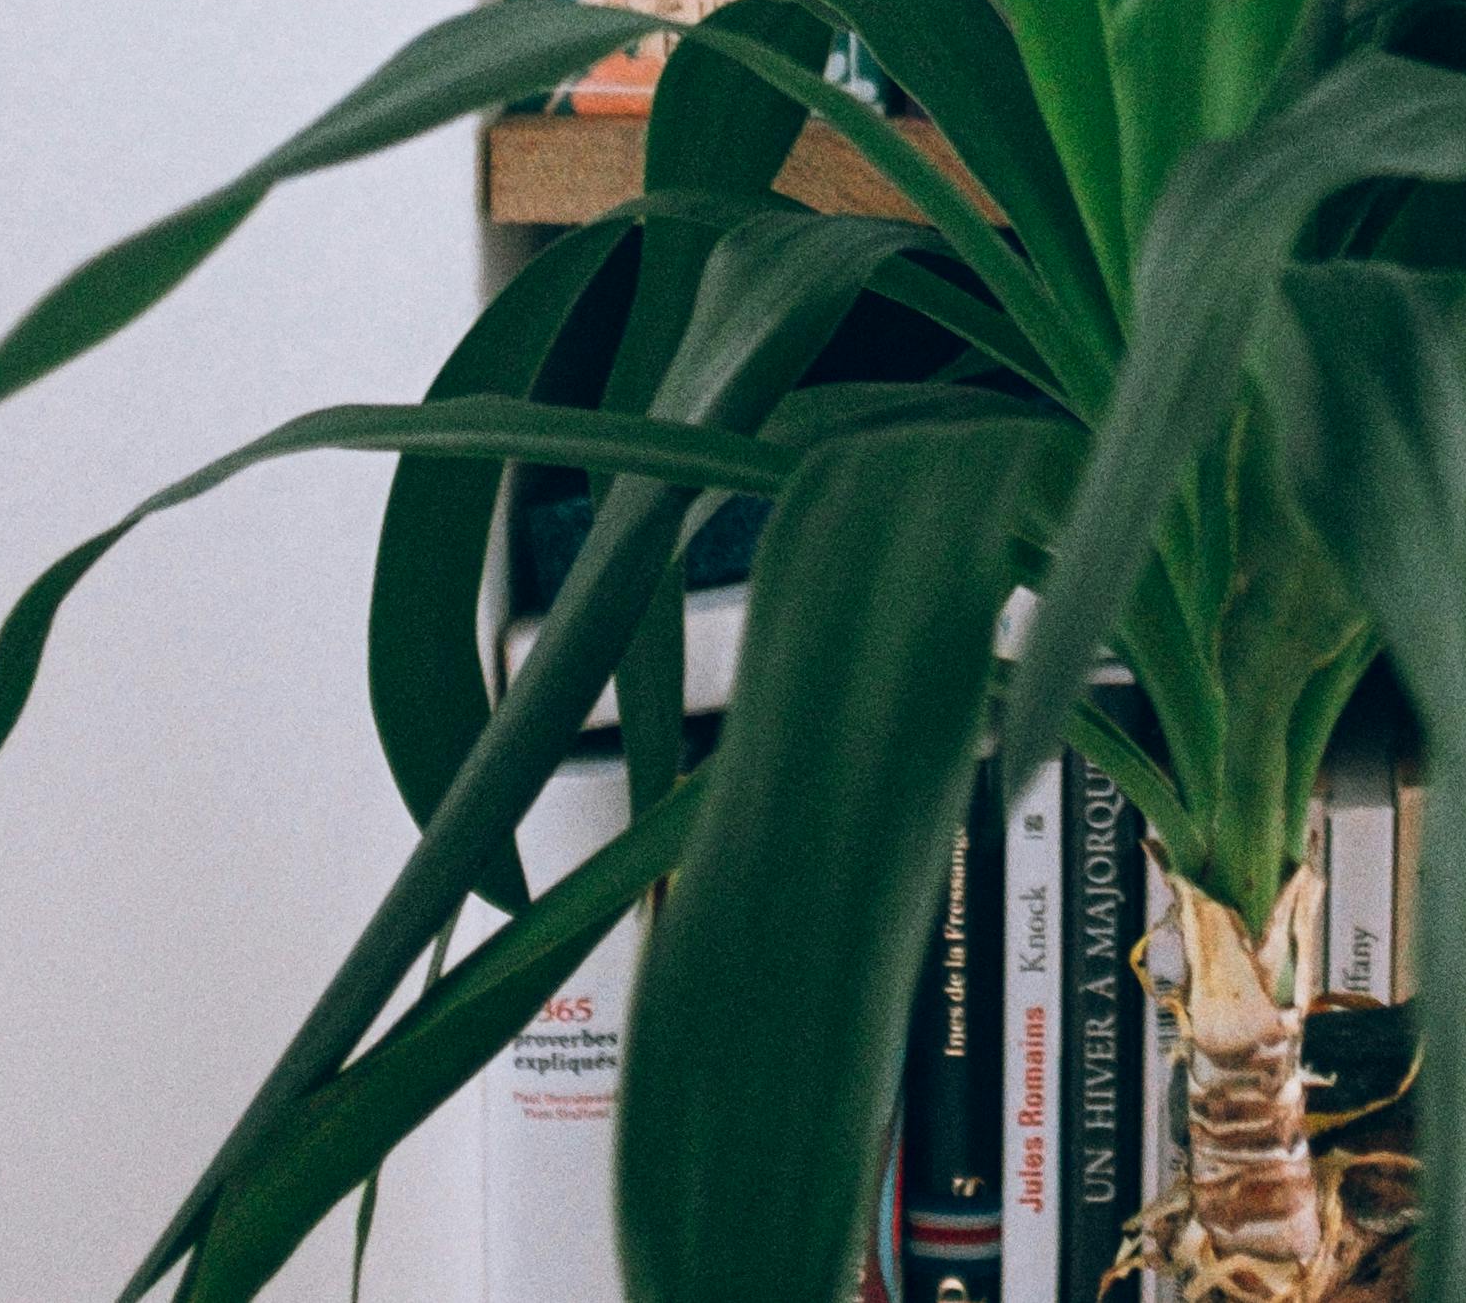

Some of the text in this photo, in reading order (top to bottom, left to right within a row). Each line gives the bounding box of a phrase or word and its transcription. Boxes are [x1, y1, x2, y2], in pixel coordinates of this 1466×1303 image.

[1084, 761, 1127, 960] MAJORQU
[1017, 885, 1048, 974] Knock
[1342, 925, 1380, 992] ffany
[1018, 1004, 1047, 1215] Jules Romains
[1084, 1013, 1119, 1130] HIVER
[1084, 1147, 1118, 1204] UN
